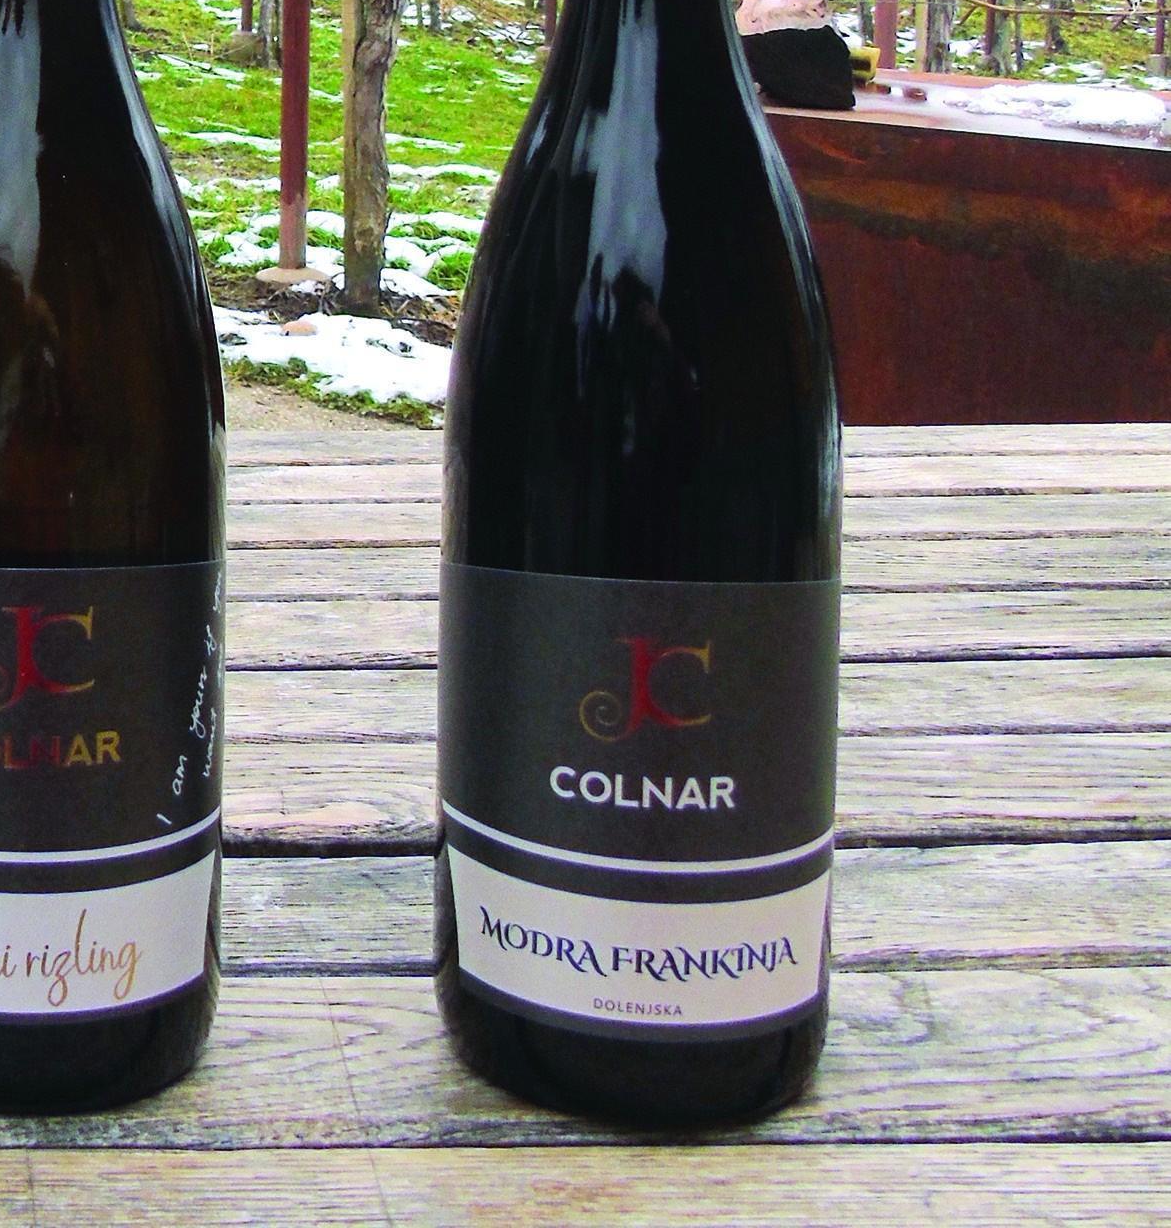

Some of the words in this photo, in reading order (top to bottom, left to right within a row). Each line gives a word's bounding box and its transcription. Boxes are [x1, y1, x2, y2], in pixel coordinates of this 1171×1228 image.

[173, 755, 188, 795] am
[549, 765, 736, 810] COLNAR
[25, 909, 142, 1007] rizling
[480, 905, 607, 978] MODRA
[611, 936, 799, 982] FRANKINJA
[593, 998, 683, 1017] DOLENJSKA
